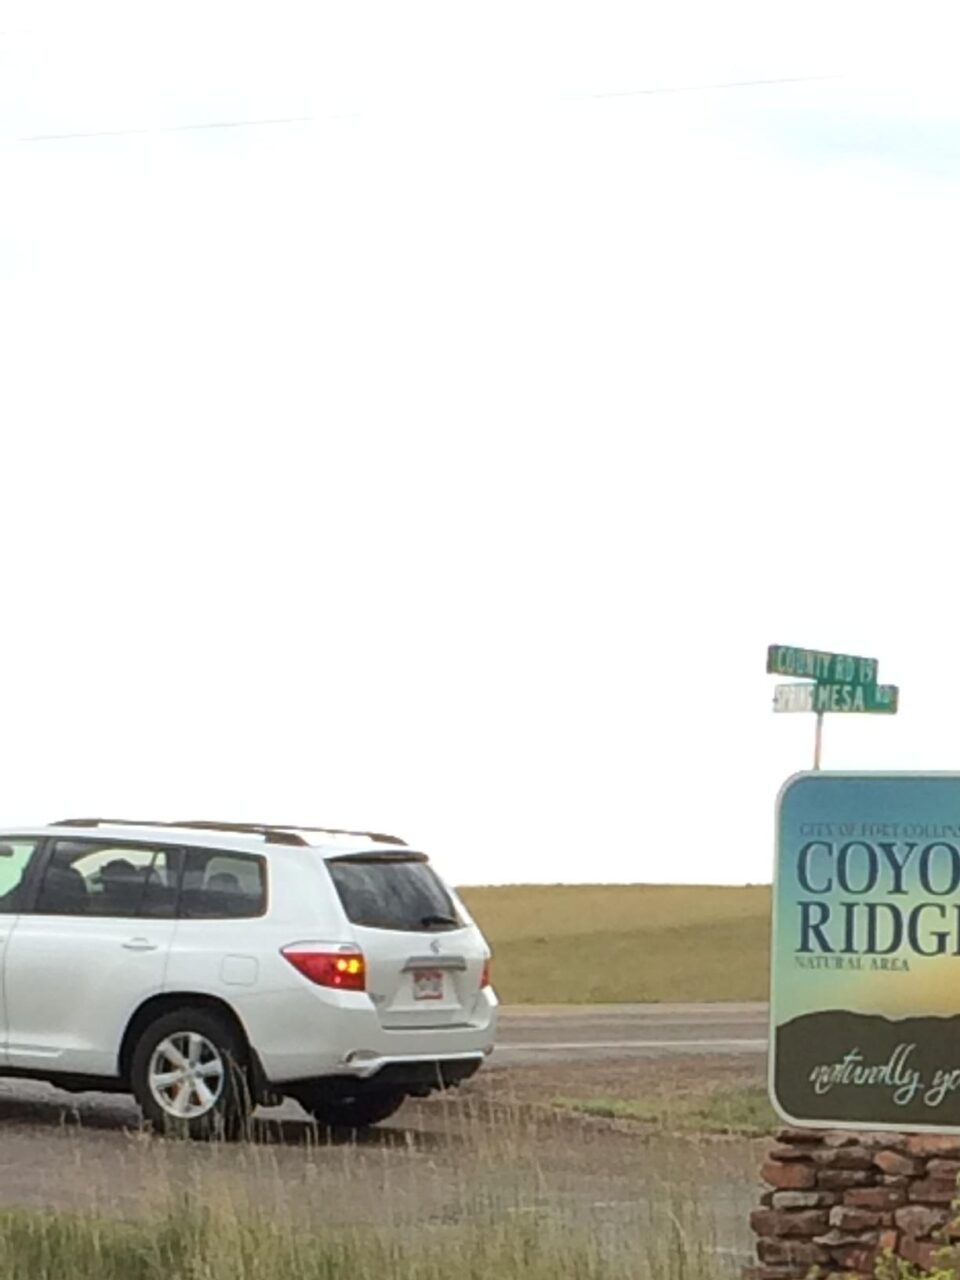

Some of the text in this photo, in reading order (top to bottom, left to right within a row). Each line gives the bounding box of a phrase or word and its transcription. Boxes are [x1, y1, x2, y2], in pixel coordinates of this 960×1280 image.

[777, 647, 832, 679] COUNTY
[835, 655, 855, 682] RD
[817, 685, 865, 711] MESA
[799, 822, 833, 837] CITY
[838, 823, 856, 837] OF
[861, 823, 899, 837] FORT
[794, 956, 910, 972] NATURAL AREA
[808, 1043, 924, 1106] naturally
